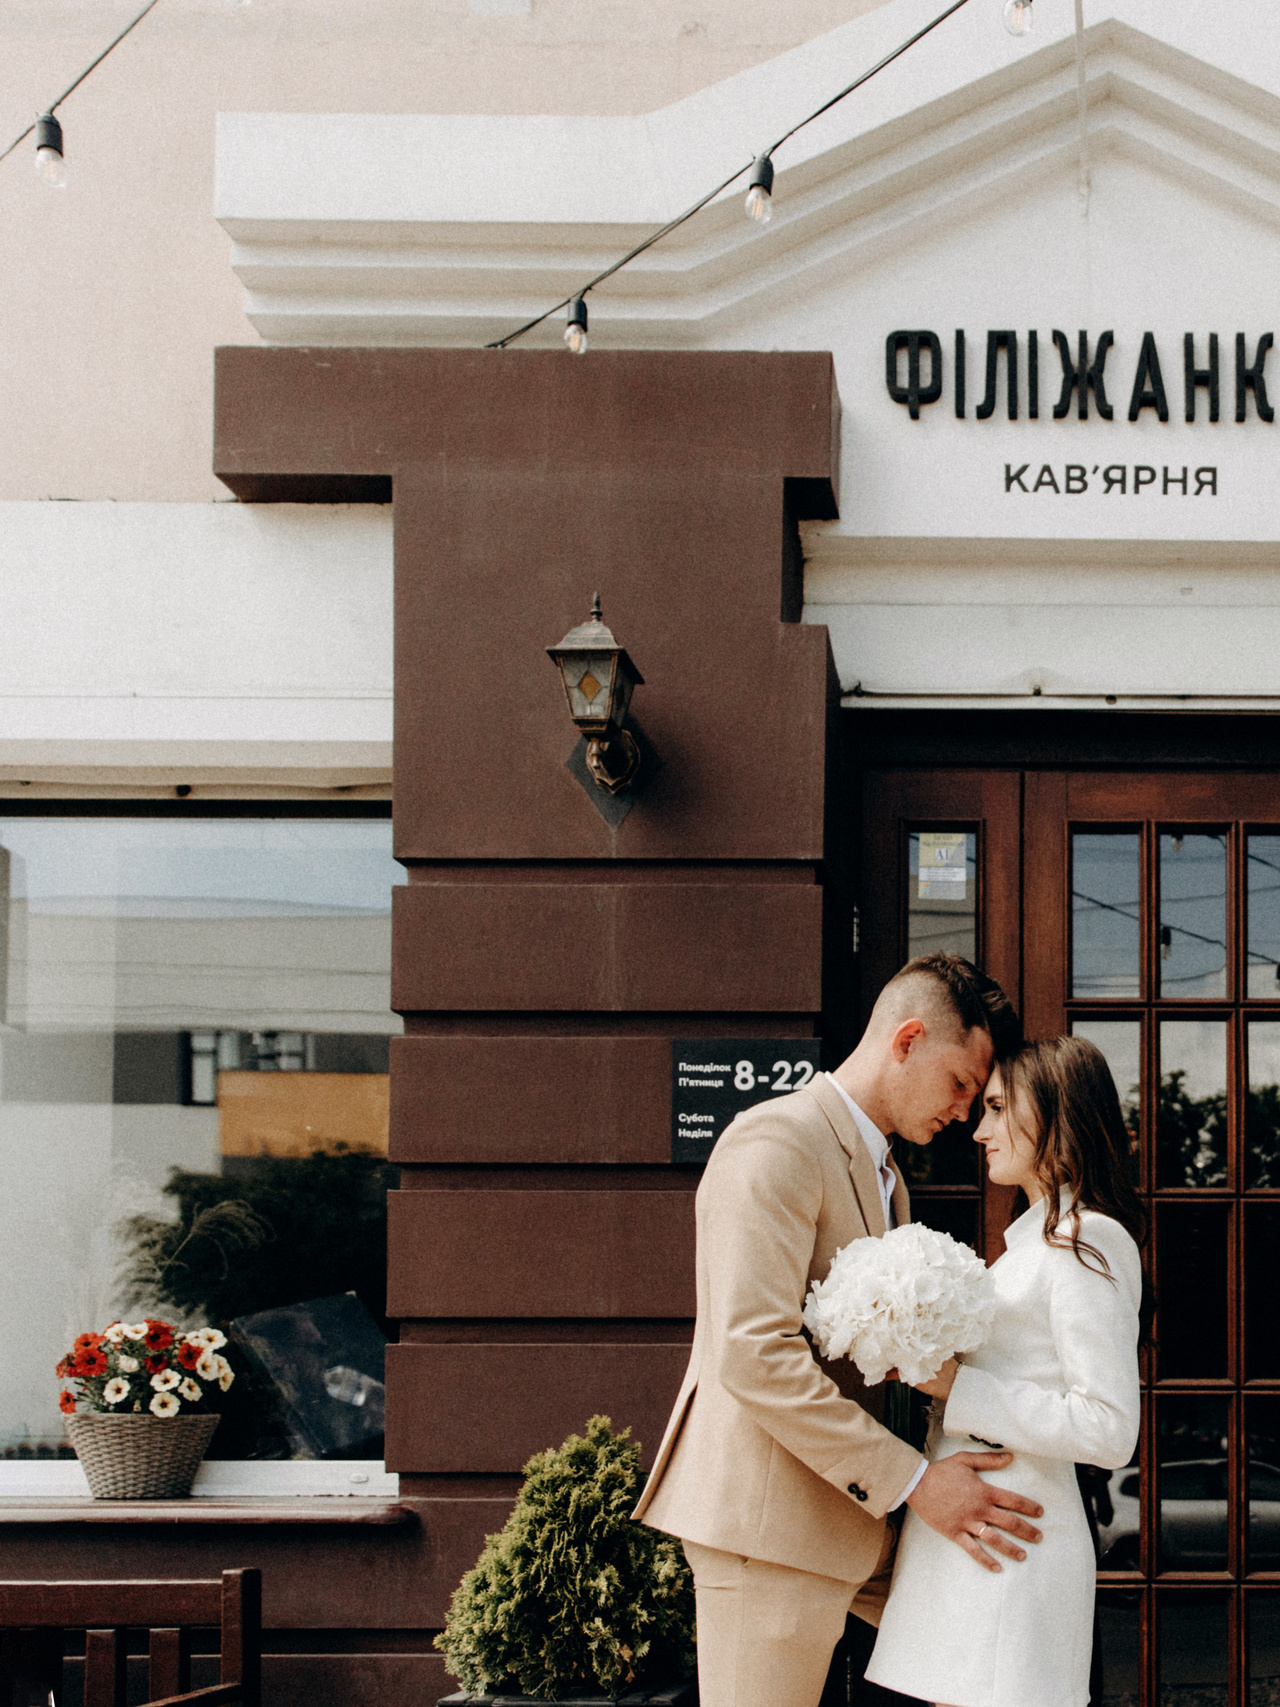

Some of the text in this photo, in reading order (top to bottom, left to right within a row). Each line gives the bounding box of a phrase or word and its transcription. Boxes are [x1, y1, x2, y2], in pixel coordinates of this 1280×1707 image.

[1004, 463, 1218, 496] КАВ'ЯРНЯ
[678, 1060, 814, 1091] Понеділок 8-22
[678, 1113, 715, 1124] Субота
[677, 1128, 713, 1139] Неділя
